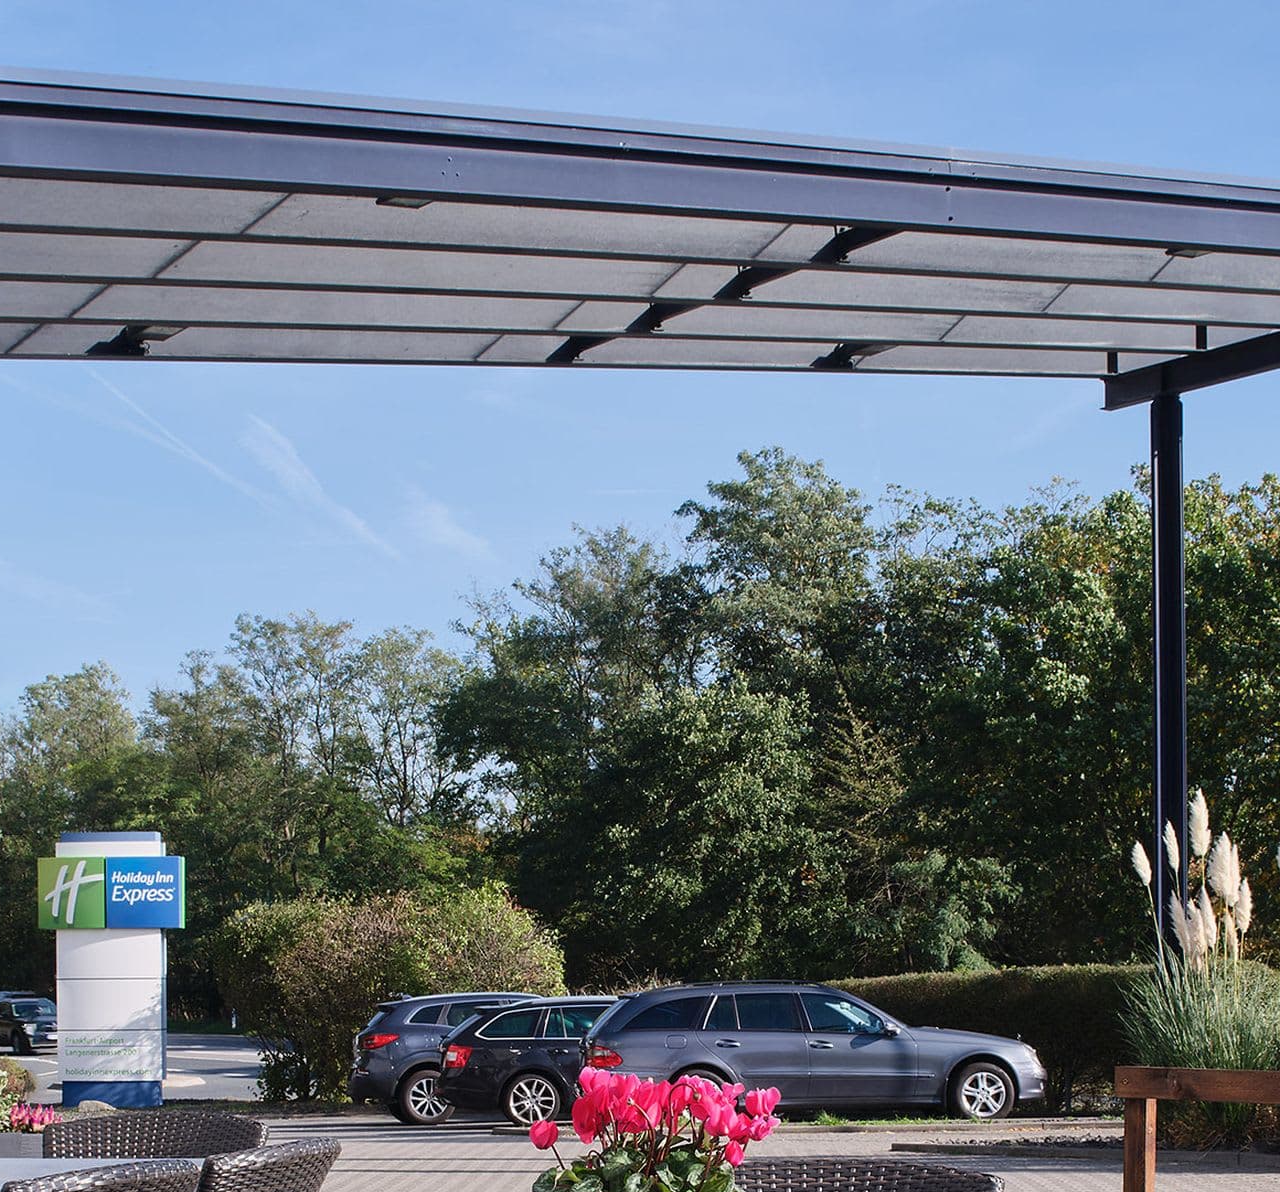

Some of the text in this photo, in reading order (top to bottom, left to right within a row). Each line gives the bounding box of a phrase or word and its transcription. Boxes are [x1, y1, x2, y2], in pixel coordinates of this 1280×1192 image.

[111, 871, 174, 886] Holiday Inn
[111, 885, 175, 905] Express
